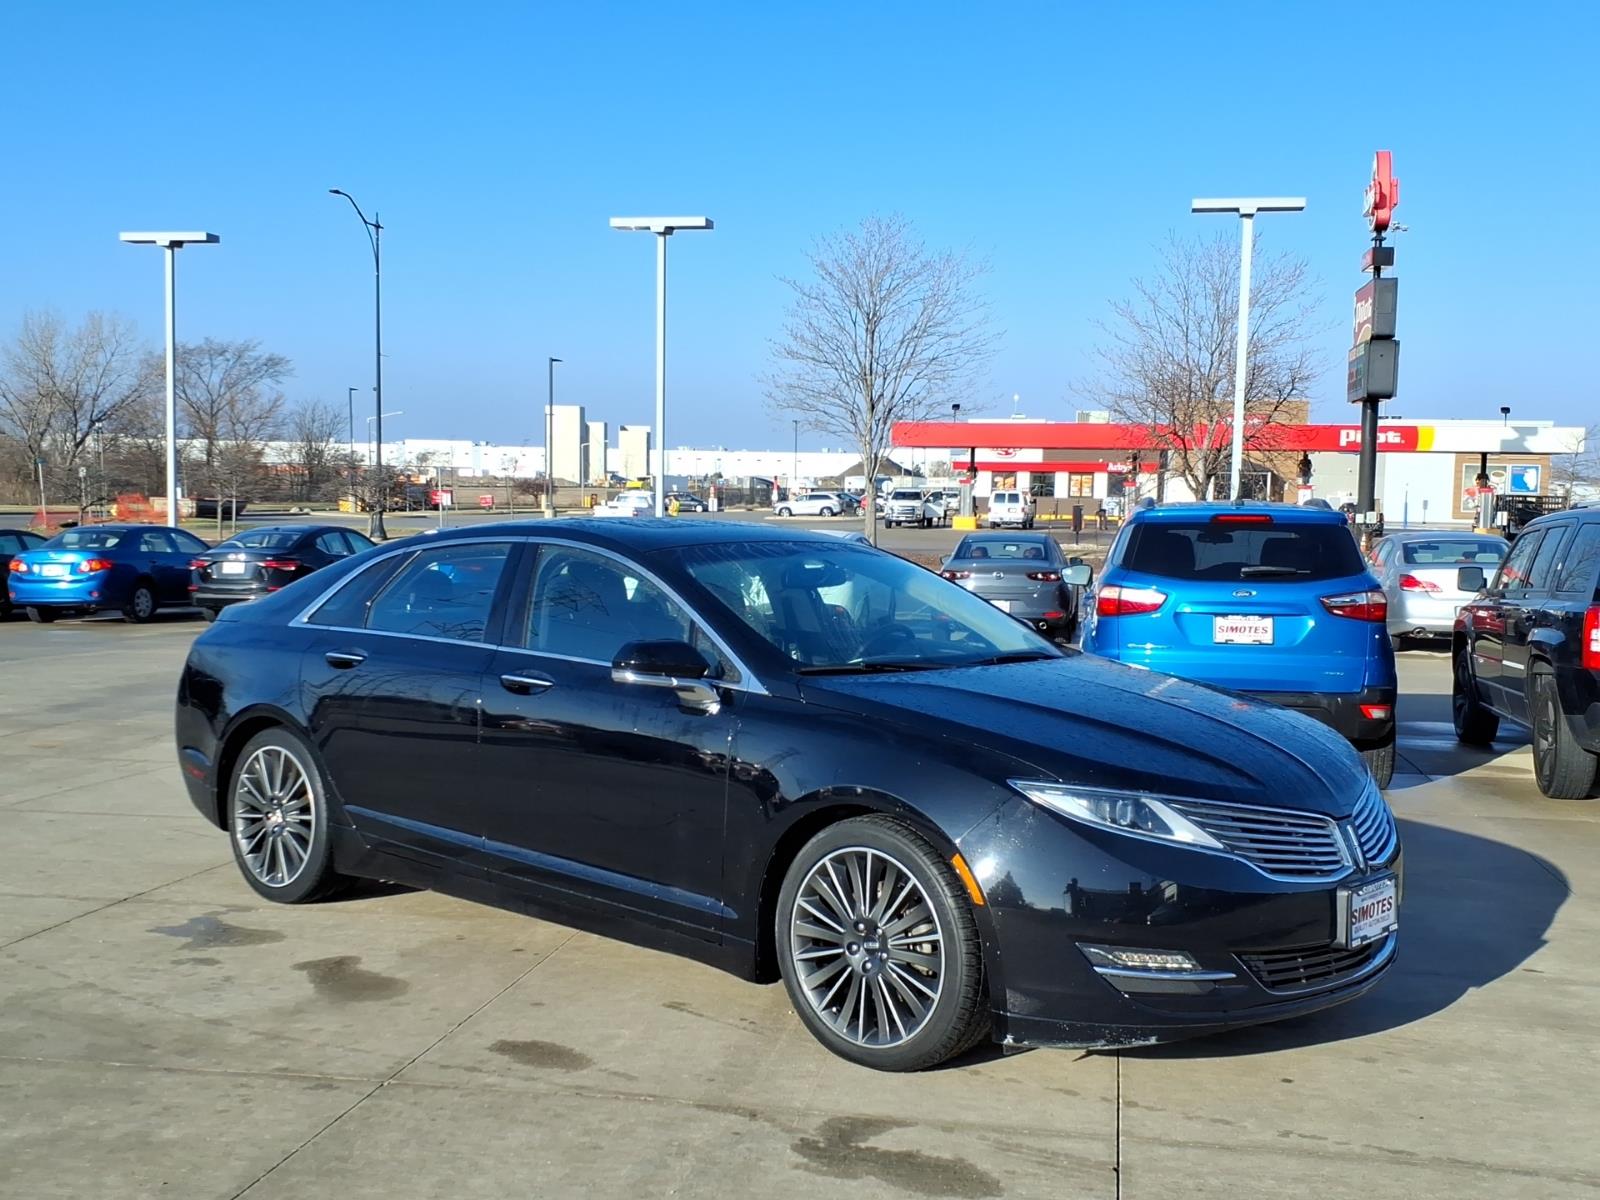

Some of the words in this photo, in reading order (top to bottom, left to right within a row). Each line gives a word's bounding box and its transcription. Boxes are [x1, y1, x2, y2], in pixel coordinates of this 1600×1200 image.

[1355, 296, 1372, 332] Pilot
[1339, 429, 1401, 447] Piot
[1217, 625, 1268, 634] SIMOTES
[1351, 896, 1393, 925] SIMOTES
